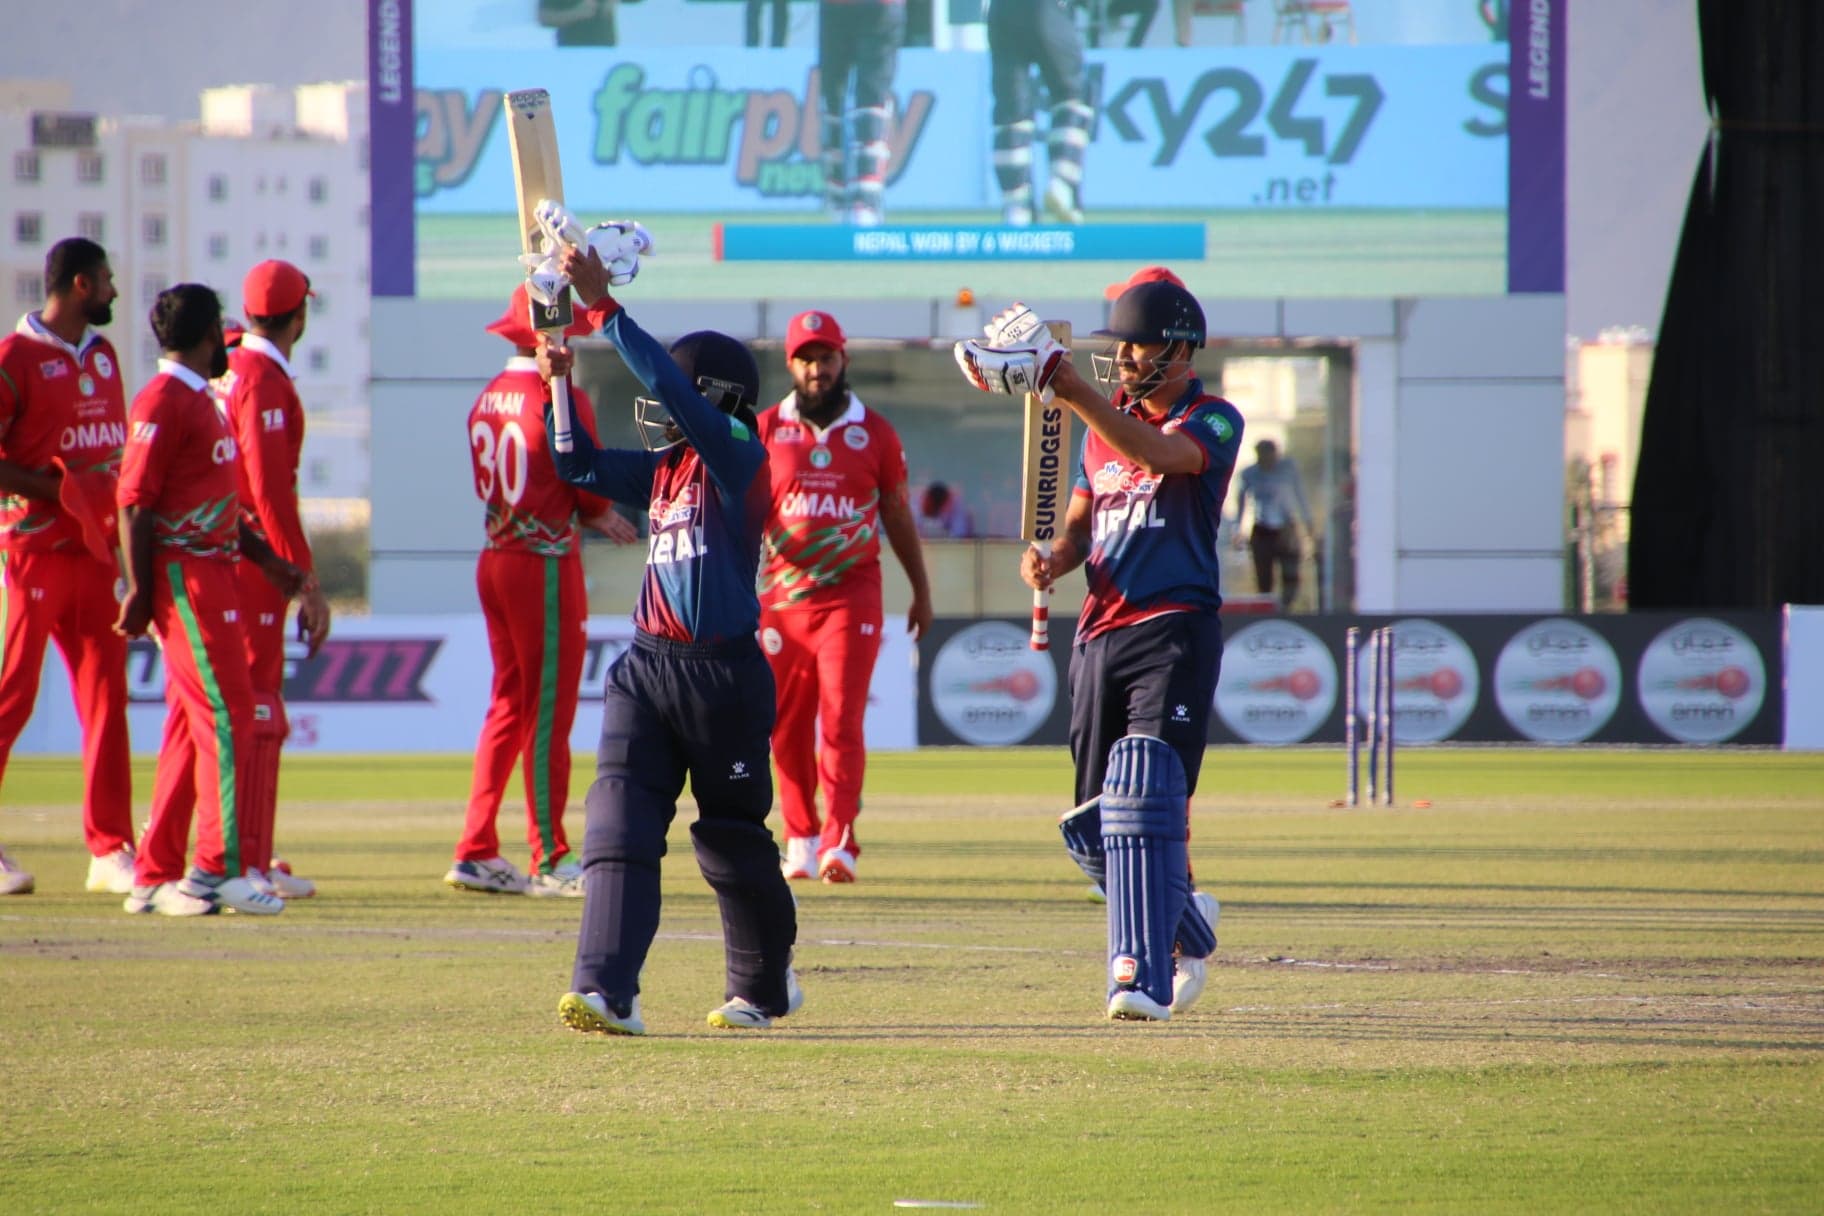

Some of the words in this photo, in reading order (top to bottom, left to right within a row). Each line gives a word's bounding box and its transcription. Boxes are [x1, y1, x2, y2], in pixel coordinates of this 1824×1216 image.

[853, 231, 909, 254] NEPAL
[911, 231, 952, 254] WON
[955, 231, 981, 253] BY
[982, 231, 996, 253] 6
[997, 231, 1075, 254] WICKETS
[480, 391, 525, 417] AYAAN
[60, 421, 125, 452] OMAN
[471, 420, 527, 506] 30
[1035, 406, 1062, 542] SUNRIDGES
[780, 491, 855, 518] OMAN
